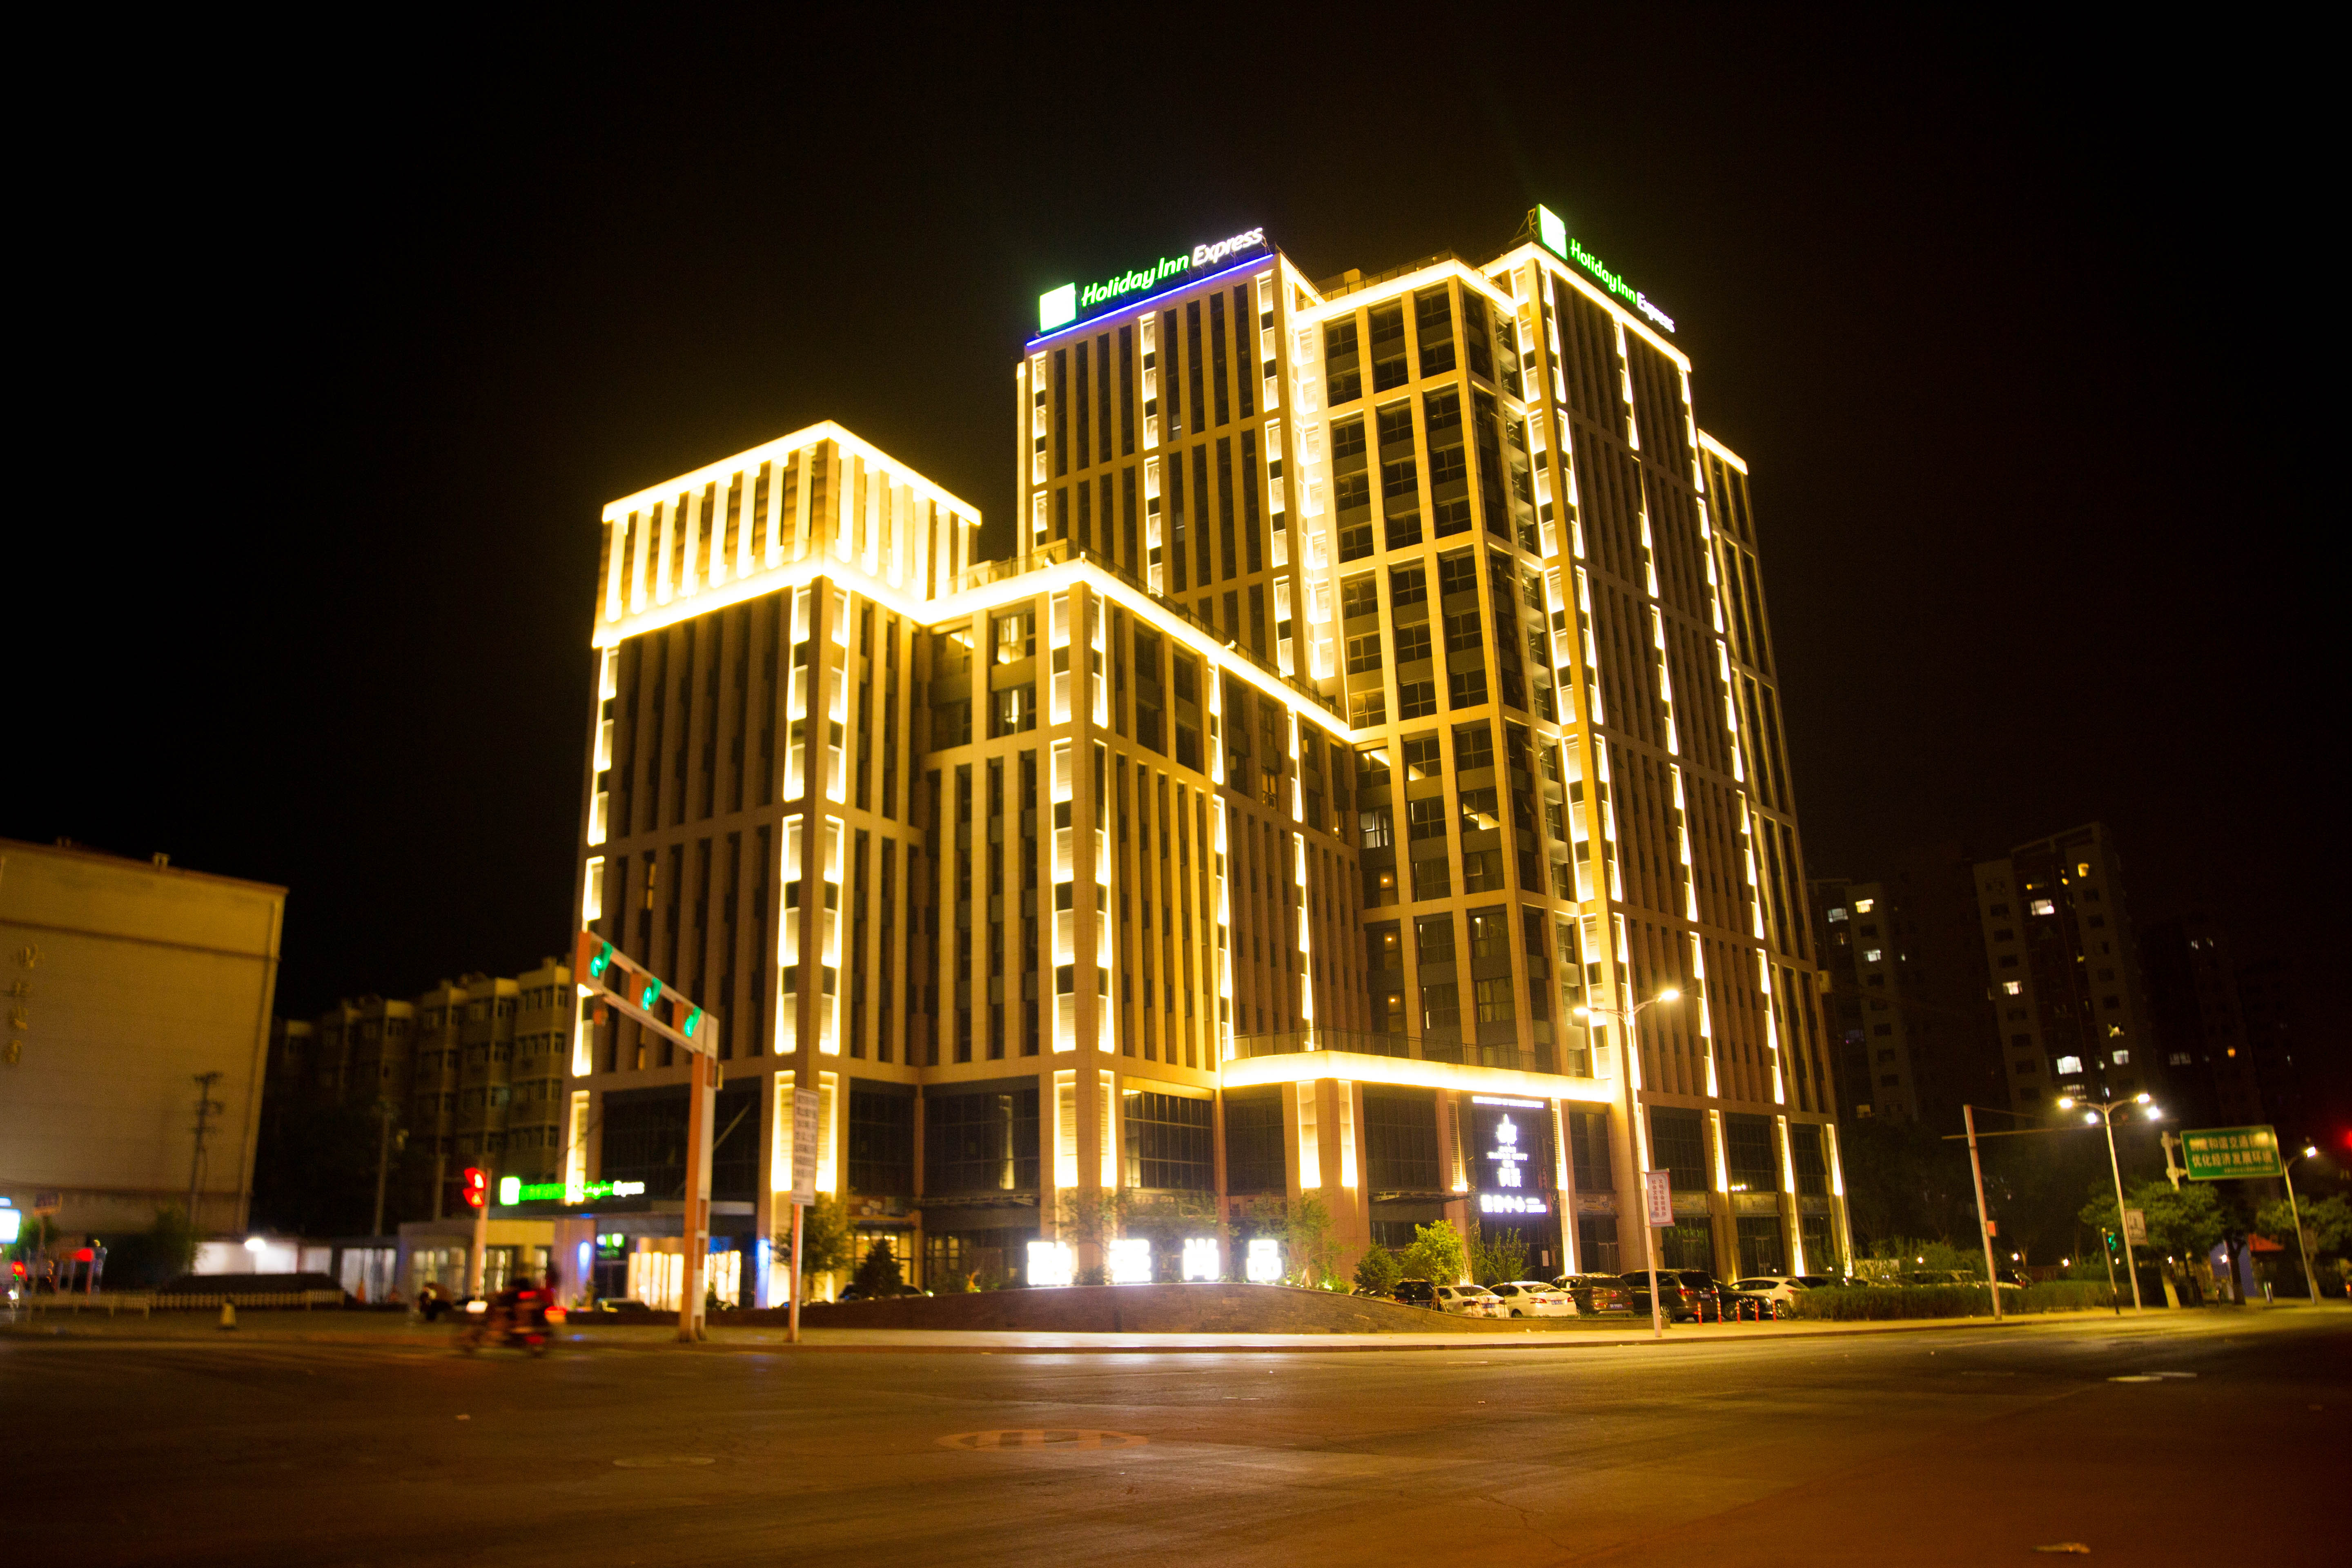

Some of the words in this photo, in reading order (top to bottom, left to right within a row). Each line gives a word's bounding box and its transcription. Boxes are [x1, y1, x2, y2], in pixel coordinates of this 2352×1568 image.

[1081, 268, 1156, 307] Holiday
[1157, 255, 1189, 279] Inn
[1192, 227, 1263, 267] Express
[1570, 238, 1617, 292] Holiday
[1617, 275, 1636, 304] Inn
